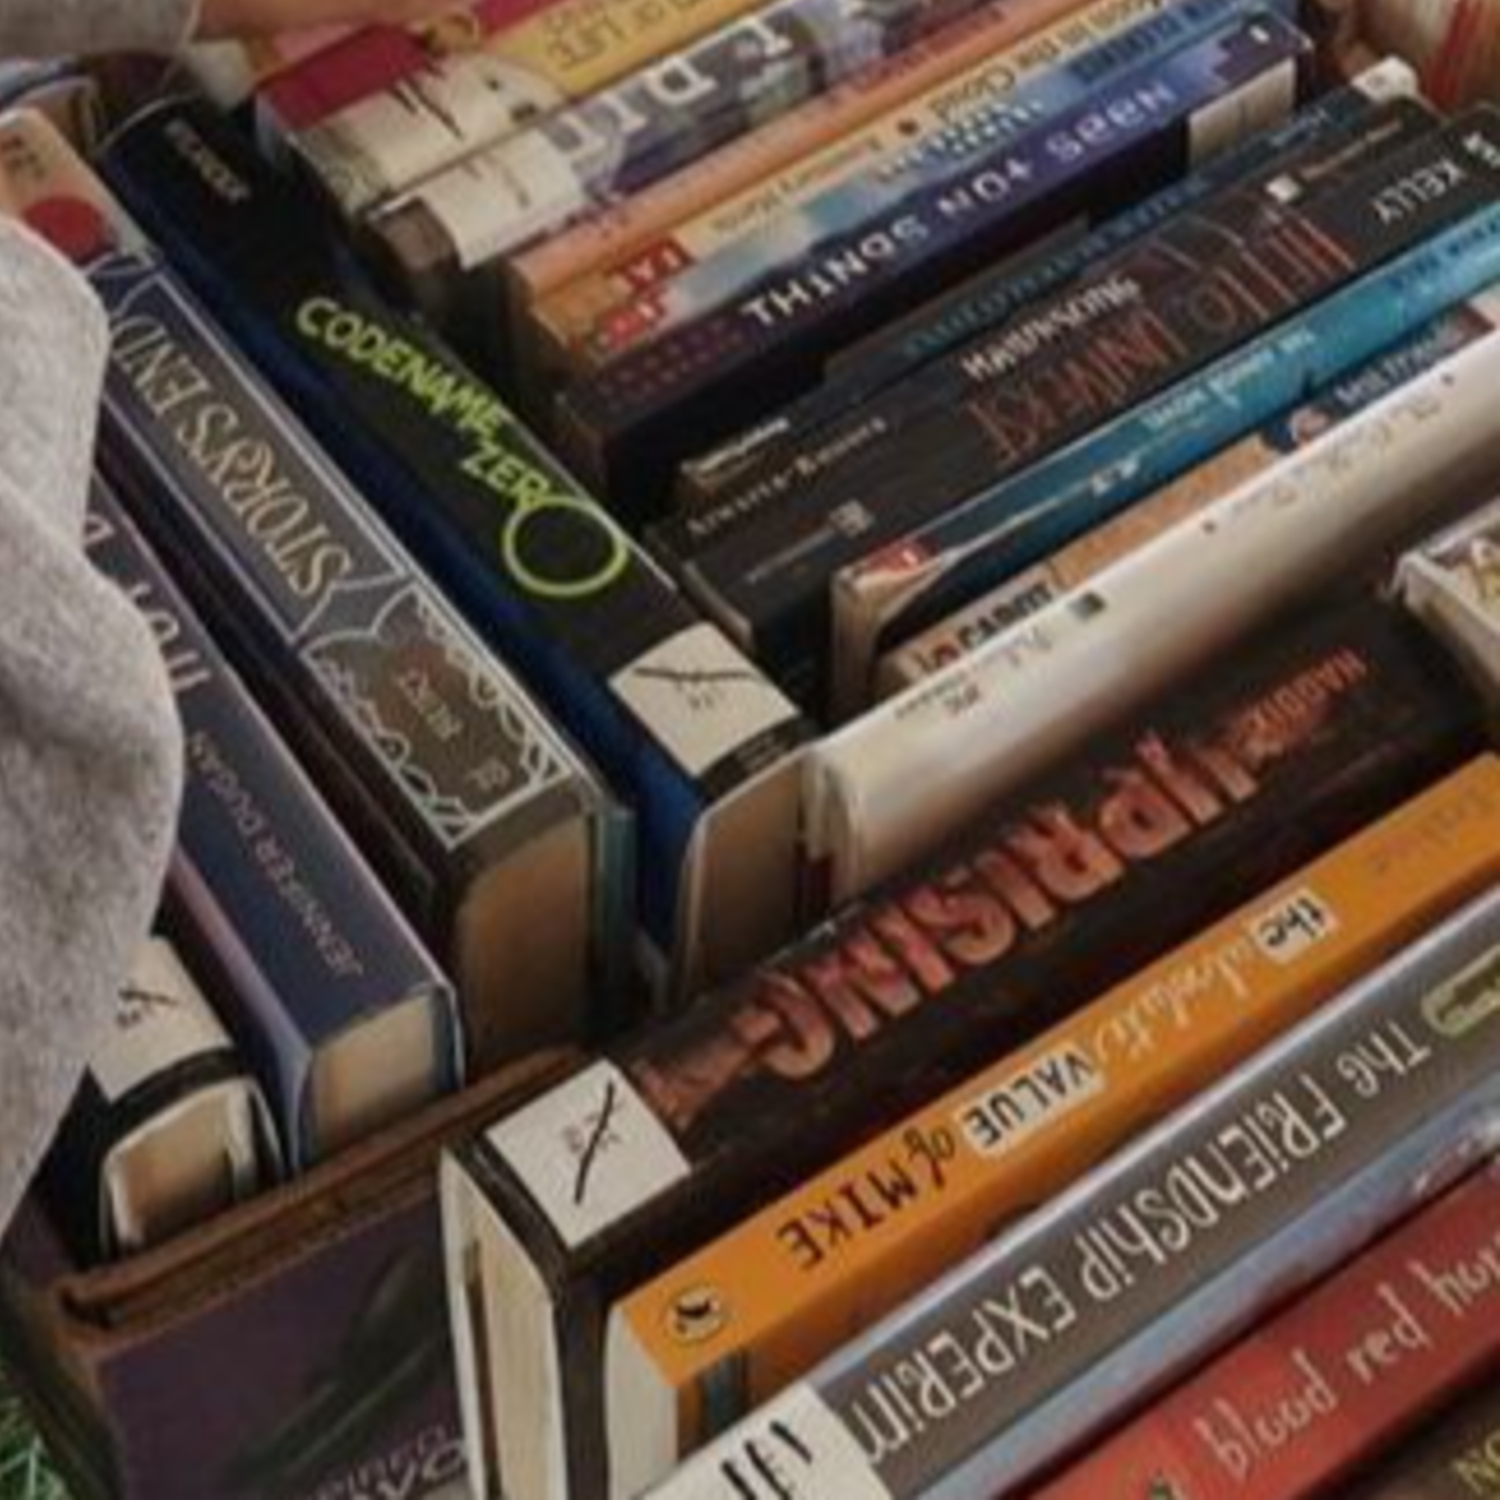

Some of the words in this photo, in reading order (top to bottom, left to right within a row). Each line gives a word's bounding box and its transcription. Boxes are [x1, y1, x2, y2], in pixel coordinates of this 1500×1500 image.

[926, 58, 1017, 125] Cloud
[1011, 36, 1059, 76] the
[1054, 18, 1090, 51] in
[738, 208, 928, 335] THINGS
[932, 150, 1036, 227] NOT
[1041, 72, 1176, 170] SEEN
[1371, 159, 1462, 225] KELLY
[107, 312, 204, 418] END
[178, 401, 353, 599] STORY'S
[297, 295, 514, 445] CODENAME
[462, 437, 628, 596] ZERO
[191, 730, 266, 844] DUGAN
[252, 835, 365, 978] JENNIFER
[755, 732, 1259, 1079] UPRISING
[1261, 895, 1324, 946] the
[893, 1112, 967, 1190] of
[968, 1048, 1094, 1148] VALUE
[773, 1154, 920, 1273] MIKE
[826, 1260, 1083, 1465] EXPERIM
[1194, 1348, 1338, 1481] blood
[1347, 1281, 1433, 1383] red
